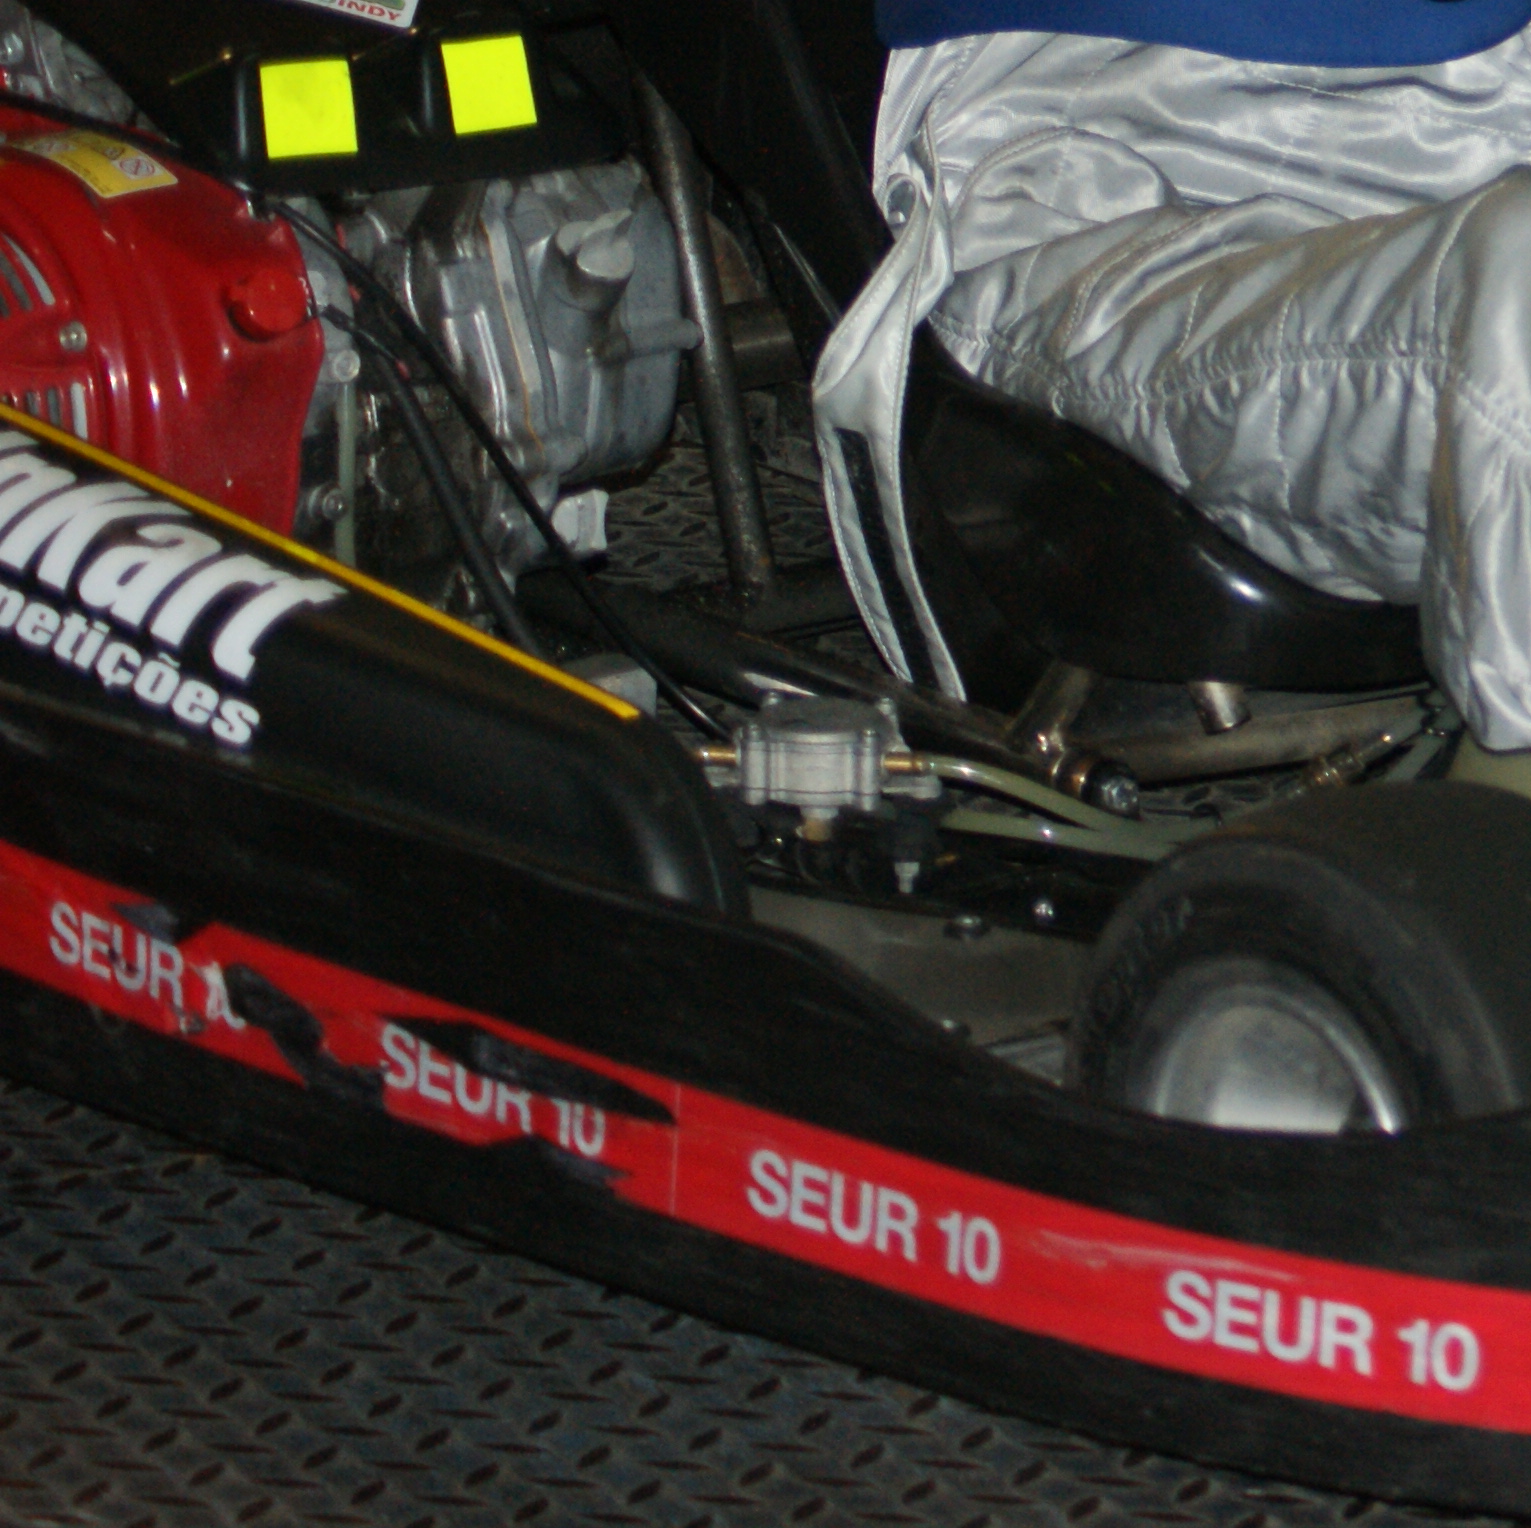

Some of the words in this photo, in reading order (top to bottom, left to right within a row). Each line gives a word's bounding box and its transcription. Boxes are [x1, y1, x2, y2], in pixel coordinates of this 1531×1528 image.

[50, 900, 184, 1010] SEUR
[746, 1149, 918, 1262] SEUR
[937, 1213, 1000, 1284] 10
[1163, 1269, 1374, 1377] SEUR
[1397, 1318, 1482, 1393] 10
